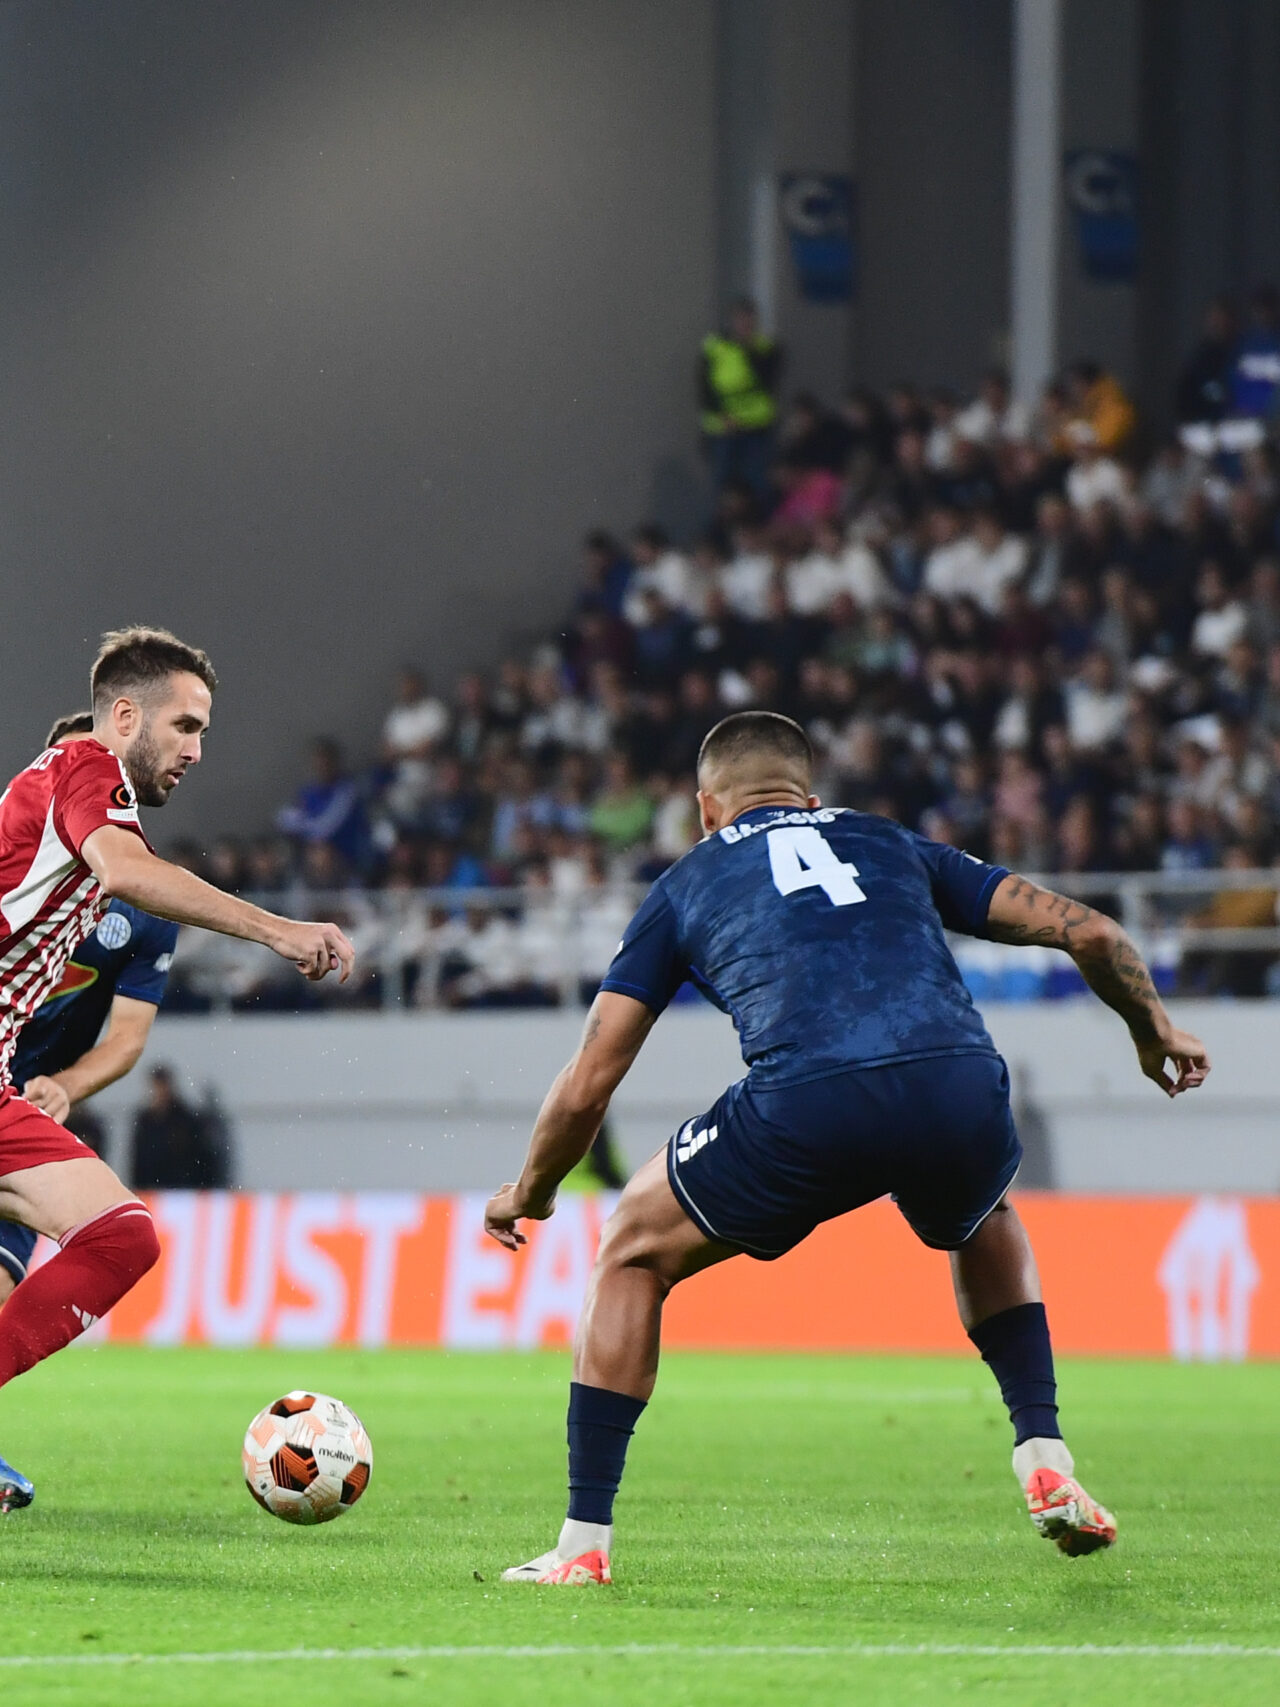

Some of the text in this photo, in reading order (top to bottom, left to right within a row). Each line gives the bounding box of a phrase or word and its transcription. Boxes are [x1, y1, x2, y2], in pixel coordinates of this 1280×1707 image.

[766, 826, 867, 907] 4
[144, 1189, 645, 1350] JUST EA
[318, 1447, 355, 1464] molten
